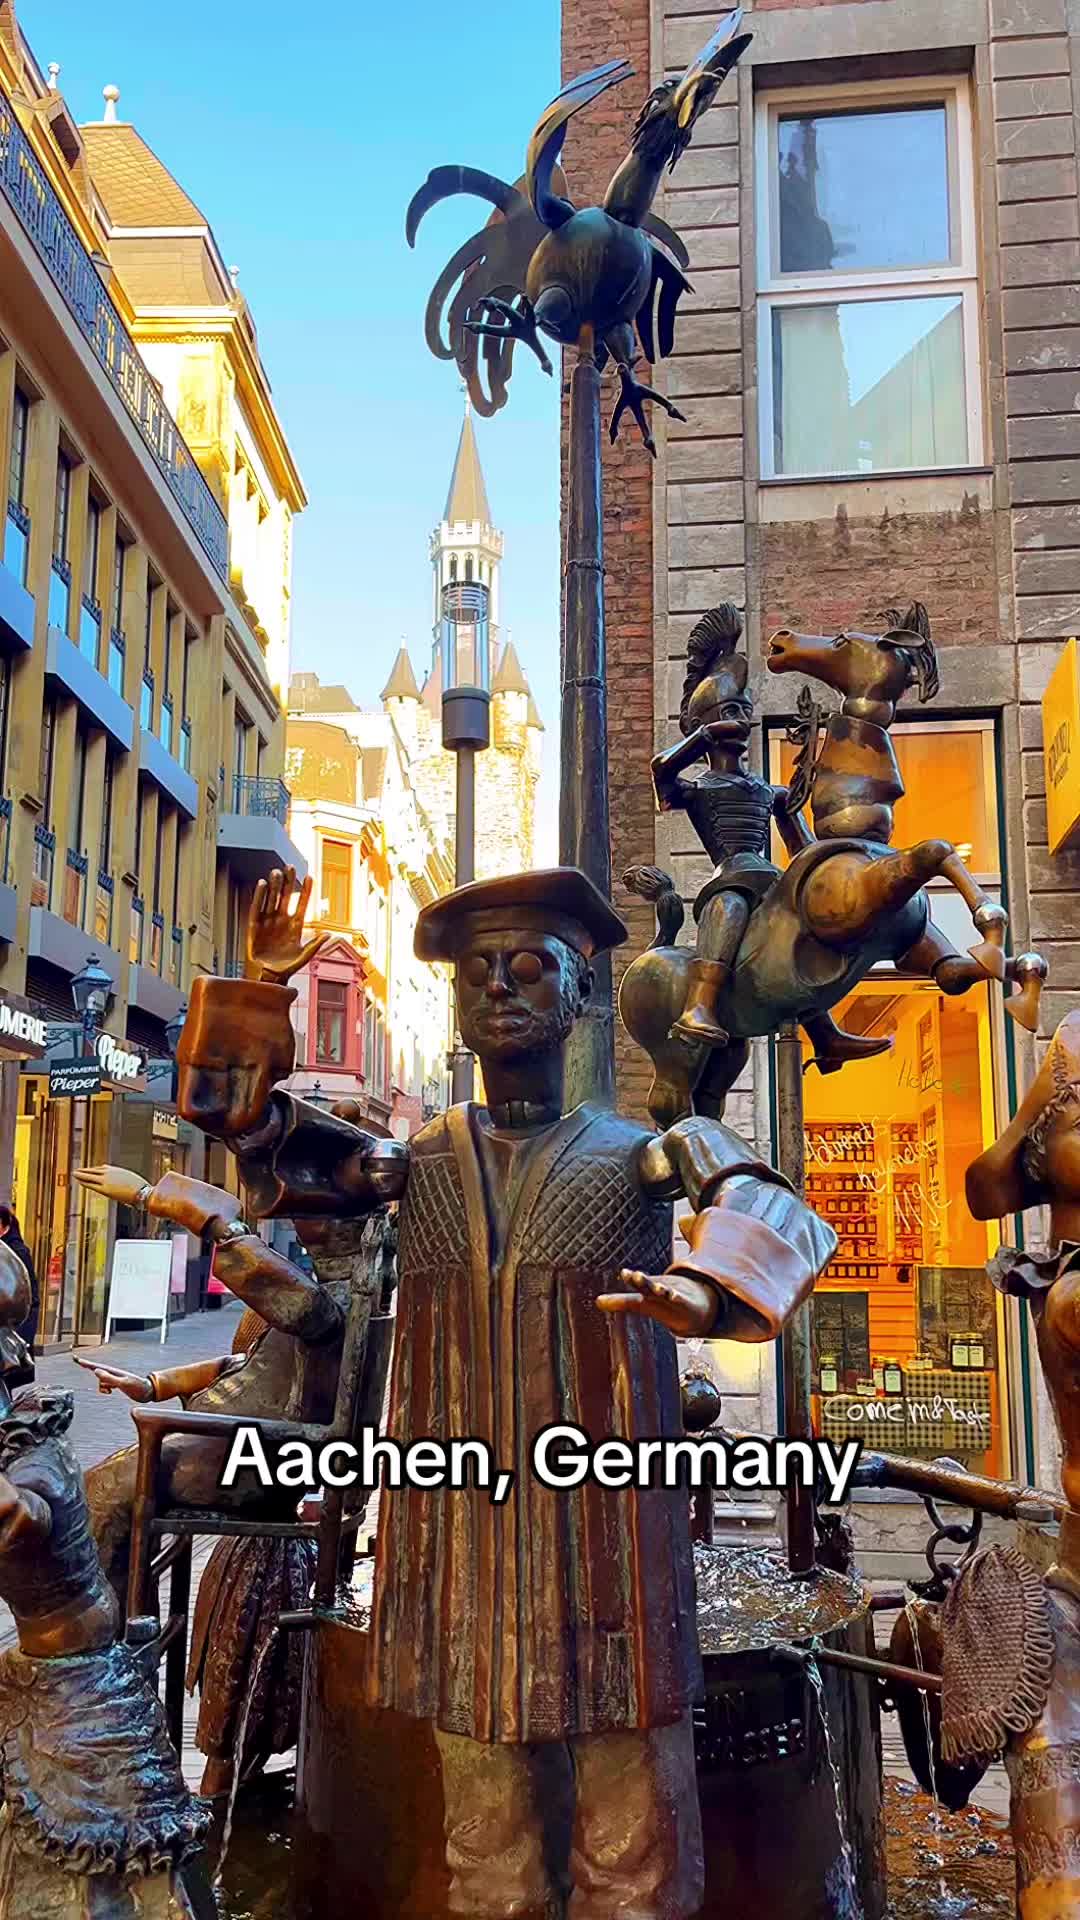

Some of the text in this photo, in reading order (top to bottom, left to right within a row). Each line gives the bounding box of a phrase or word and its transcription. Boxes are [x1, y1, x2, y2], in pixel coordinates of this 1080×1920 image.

[96, 1035, 142, 1080] Pieper
[51, 1077, 99, 1091] Pieper
[824, 1394, 905, 1422] Come
